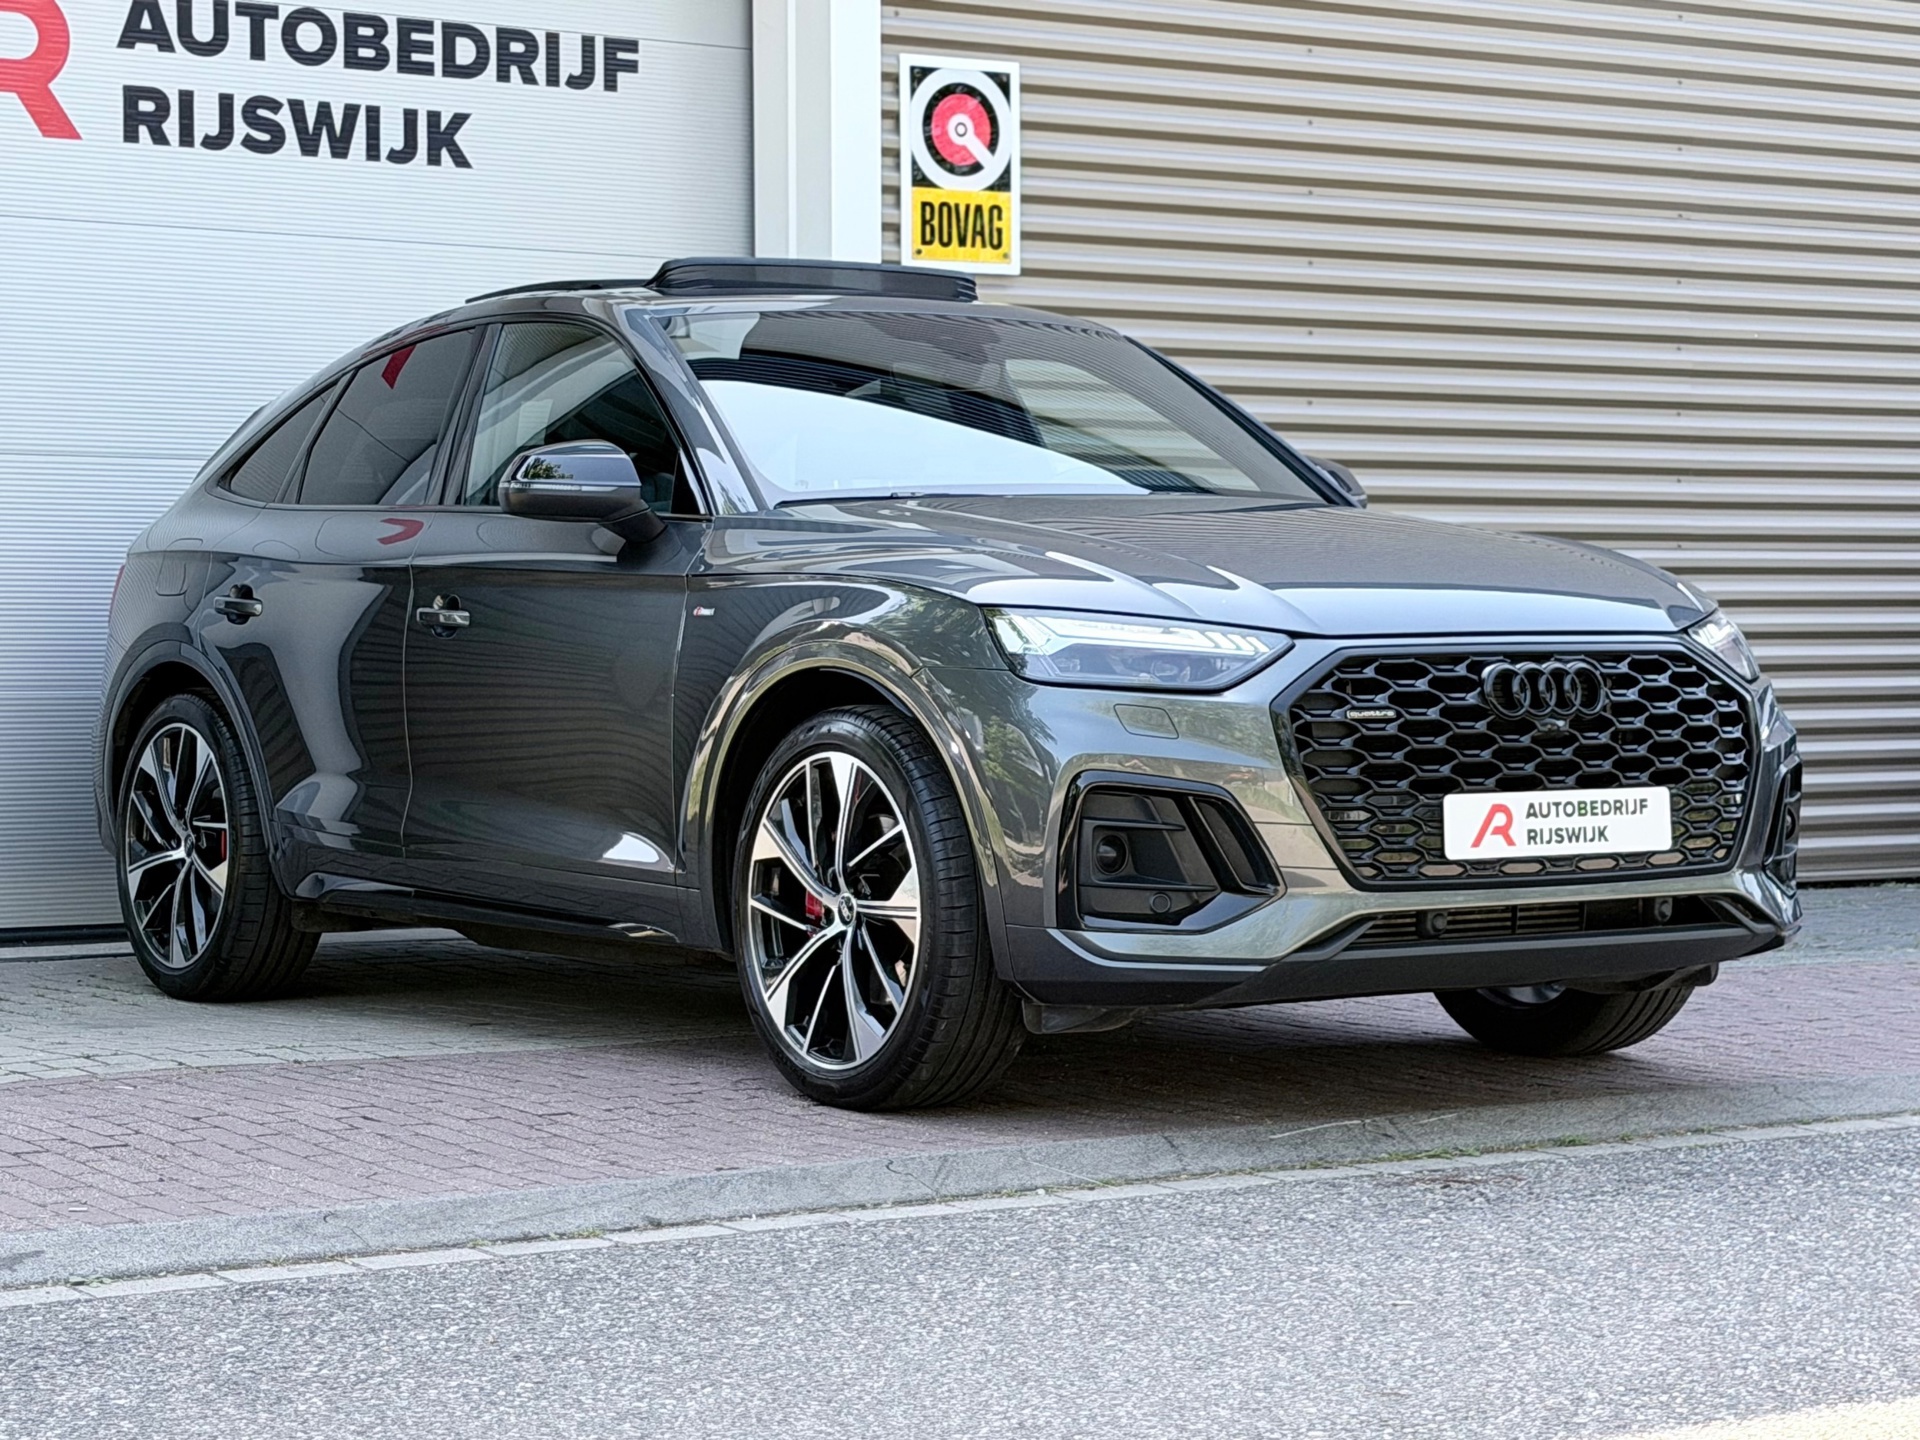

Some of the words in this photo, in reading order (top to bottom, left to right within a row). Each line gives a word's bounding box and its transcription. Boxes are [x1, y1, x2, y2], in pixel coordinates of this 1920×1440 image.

[117, 0, 639, 92] AUTOBEDRIJF
[123, 85, 473, 169] RIJSWIJK
[921, 201, 1003, 250] BOVAG
[1526, 798, 1649, 819] AUTOBEDRIJF
[1527, 825, 1609, 846] RIJSWIJK
